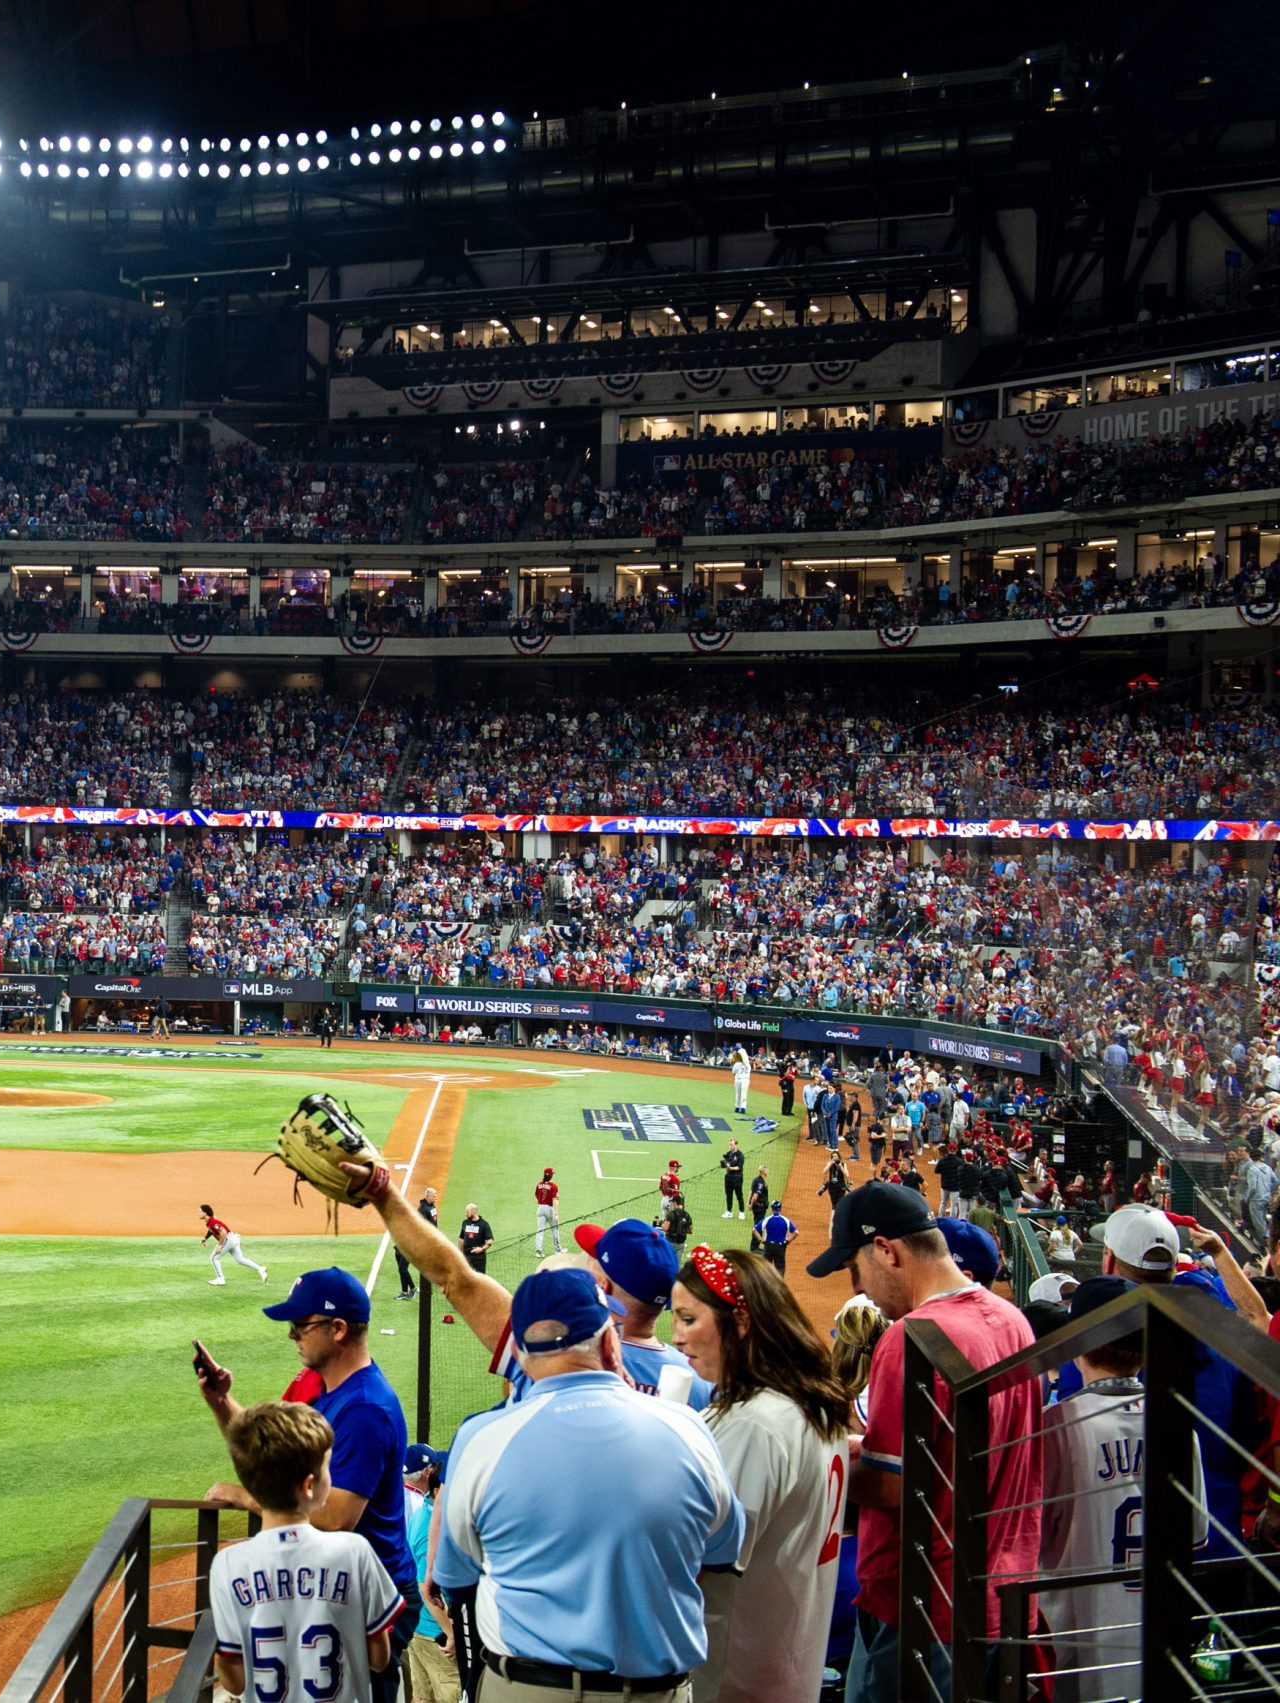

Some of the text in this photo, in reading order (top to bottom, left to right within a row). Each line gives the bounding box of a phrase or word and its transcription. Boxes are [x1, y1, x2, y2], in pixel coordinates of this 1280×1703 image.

[1085, 393, 1280, 444] HOME OF THE TE
[771, 448, 826, 466] GAME
[242, 983, 293, 996] MLB App
[375, 996, 397, 1008] FOX
[435, 999, 484, 1012] WORLD
[485, 1001, 532, 1015] SERIES
[533, 1005, 559, 1014] 2023
[724, 1018, 780, 1032] Globe Life Field
[938, 1038, 964, 1056] WORLD
[964, 1044, 991, 1061] SERIES
[231, 1566, 351, 1609] GARCIA
[250, 1623, 343, 1703] 53
